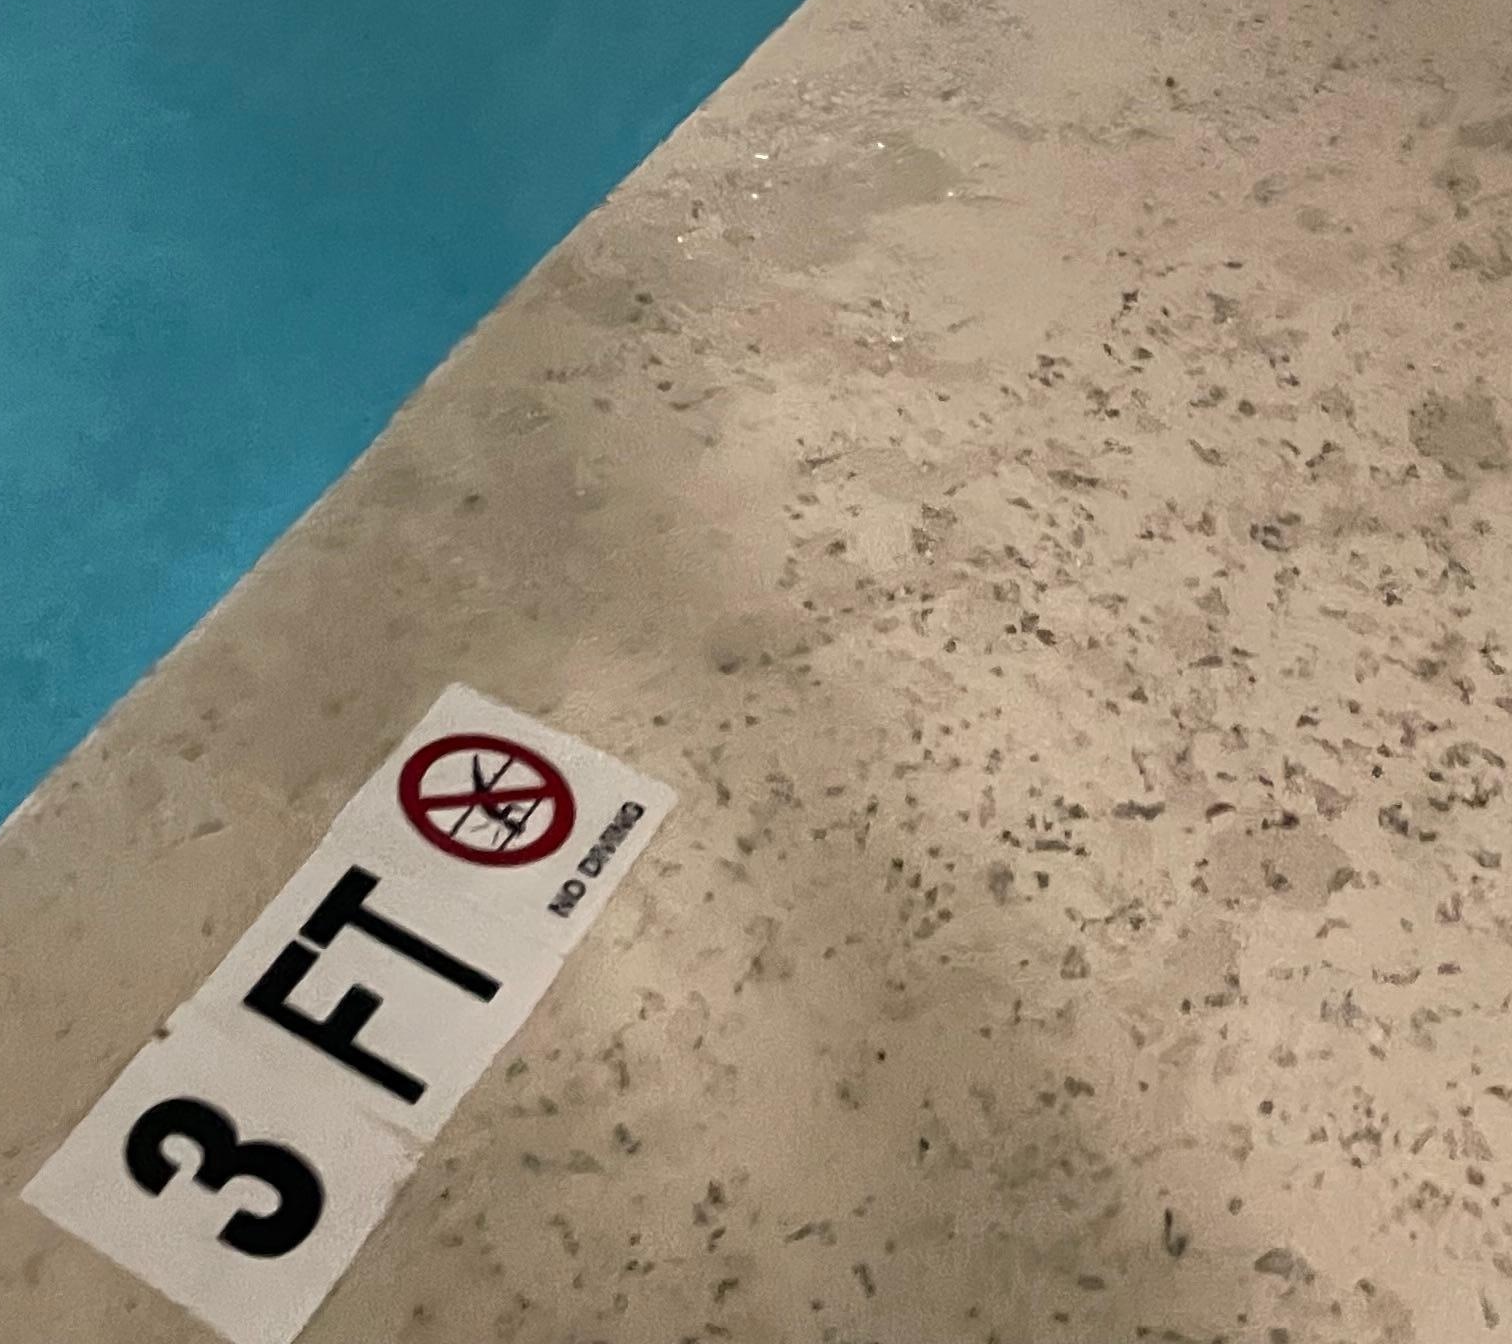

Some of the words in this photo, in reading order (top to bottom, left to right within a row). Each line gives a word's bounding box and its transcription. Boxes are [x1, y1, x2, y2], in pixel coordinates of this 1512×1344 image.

[548, 879, 587, 918] NO
[577, 801, 646, 878] DIVING
[125, 1097, 325, 1259] 3
[243, 864, 503, 1105] FT
